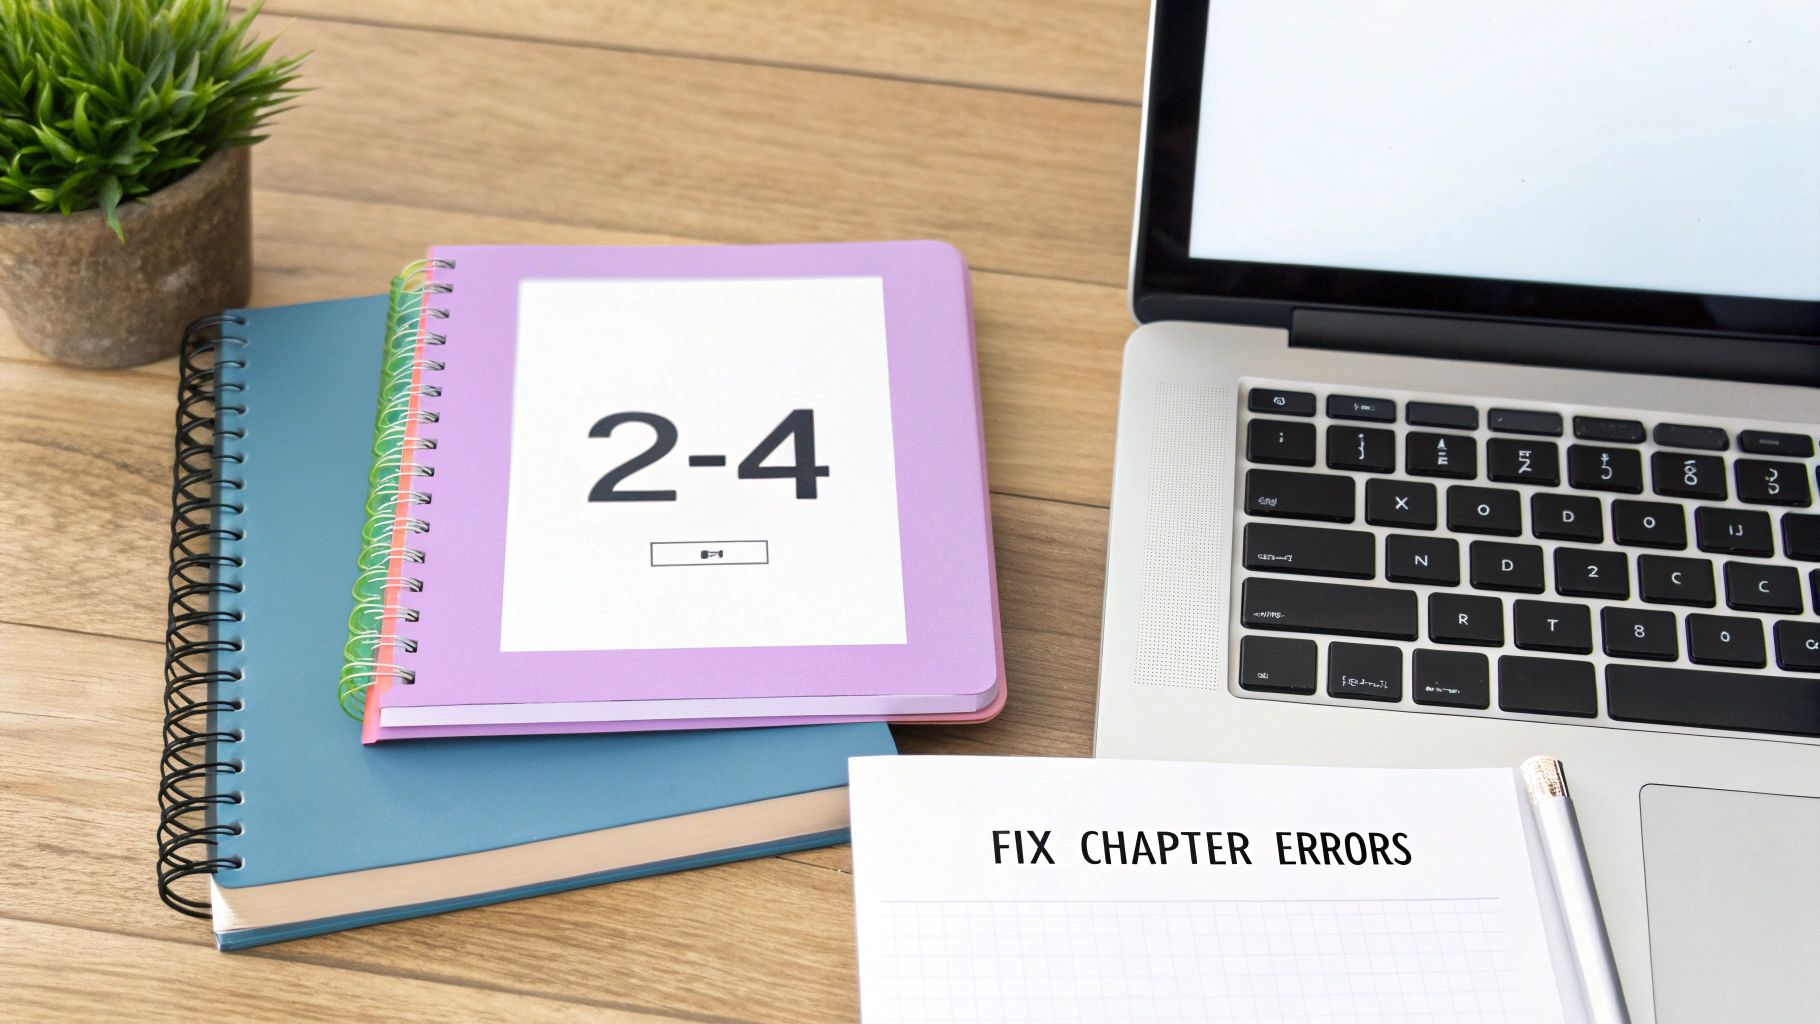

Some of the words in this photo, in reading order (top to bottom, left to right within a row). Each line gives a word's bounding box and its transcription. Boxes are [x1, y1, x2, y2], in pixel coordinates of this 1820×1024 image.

[588, 409, 830, 503] 2-4
[1395, 496, 1409, 510] X
[1562, 510, 1575, 523] D
[1414, 554, 1428, 567] N
[1501, 559, 1514, 572] D
[1587, 565, 1599, 578] 2
[1671, 571, 1682, 585] C
[1758, 580, 1770, 593] C
[1458, 613, 1469, 626] R
[1546, 618, 1559, 632] T
[1634, 624, 1646, 638] 8
[992, 830, 1056, 865] FIX
[1080, 830, 1253, 865] CHAPTER
[1275, 831, 1412, 866] ERRORS
